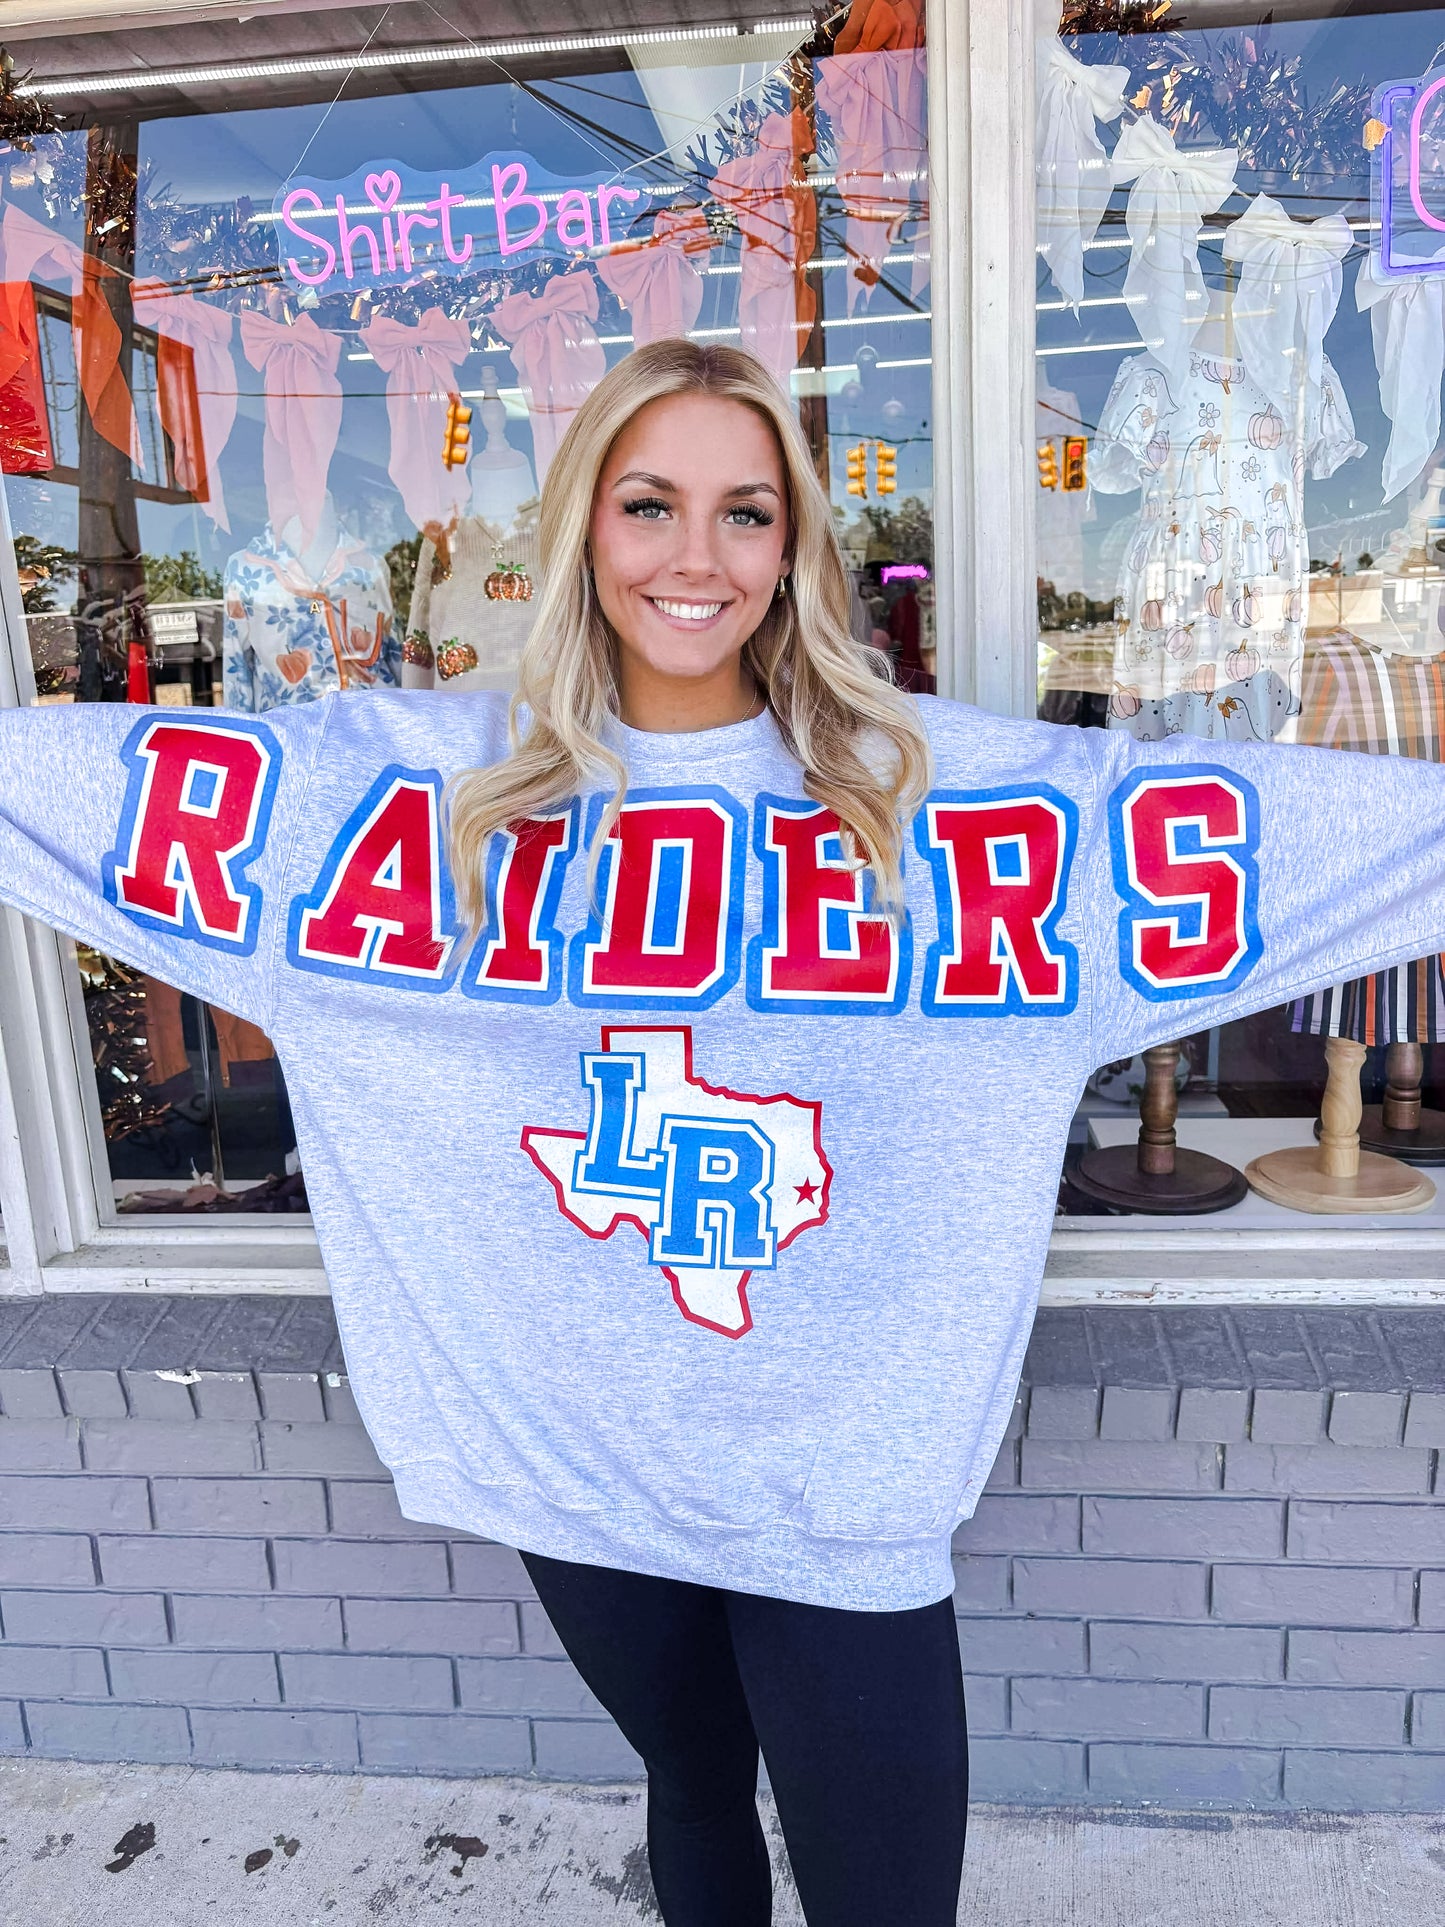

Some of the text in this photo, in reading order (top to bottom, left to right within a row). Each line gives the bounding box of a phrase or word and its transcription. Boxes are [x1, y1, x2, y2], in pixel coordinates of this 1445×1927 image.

[282, 162, 641, 286] Shirt Bar
[101, 712, 1264, 1018] RAIDERS
[571, 1050, 778, 1270] LR
